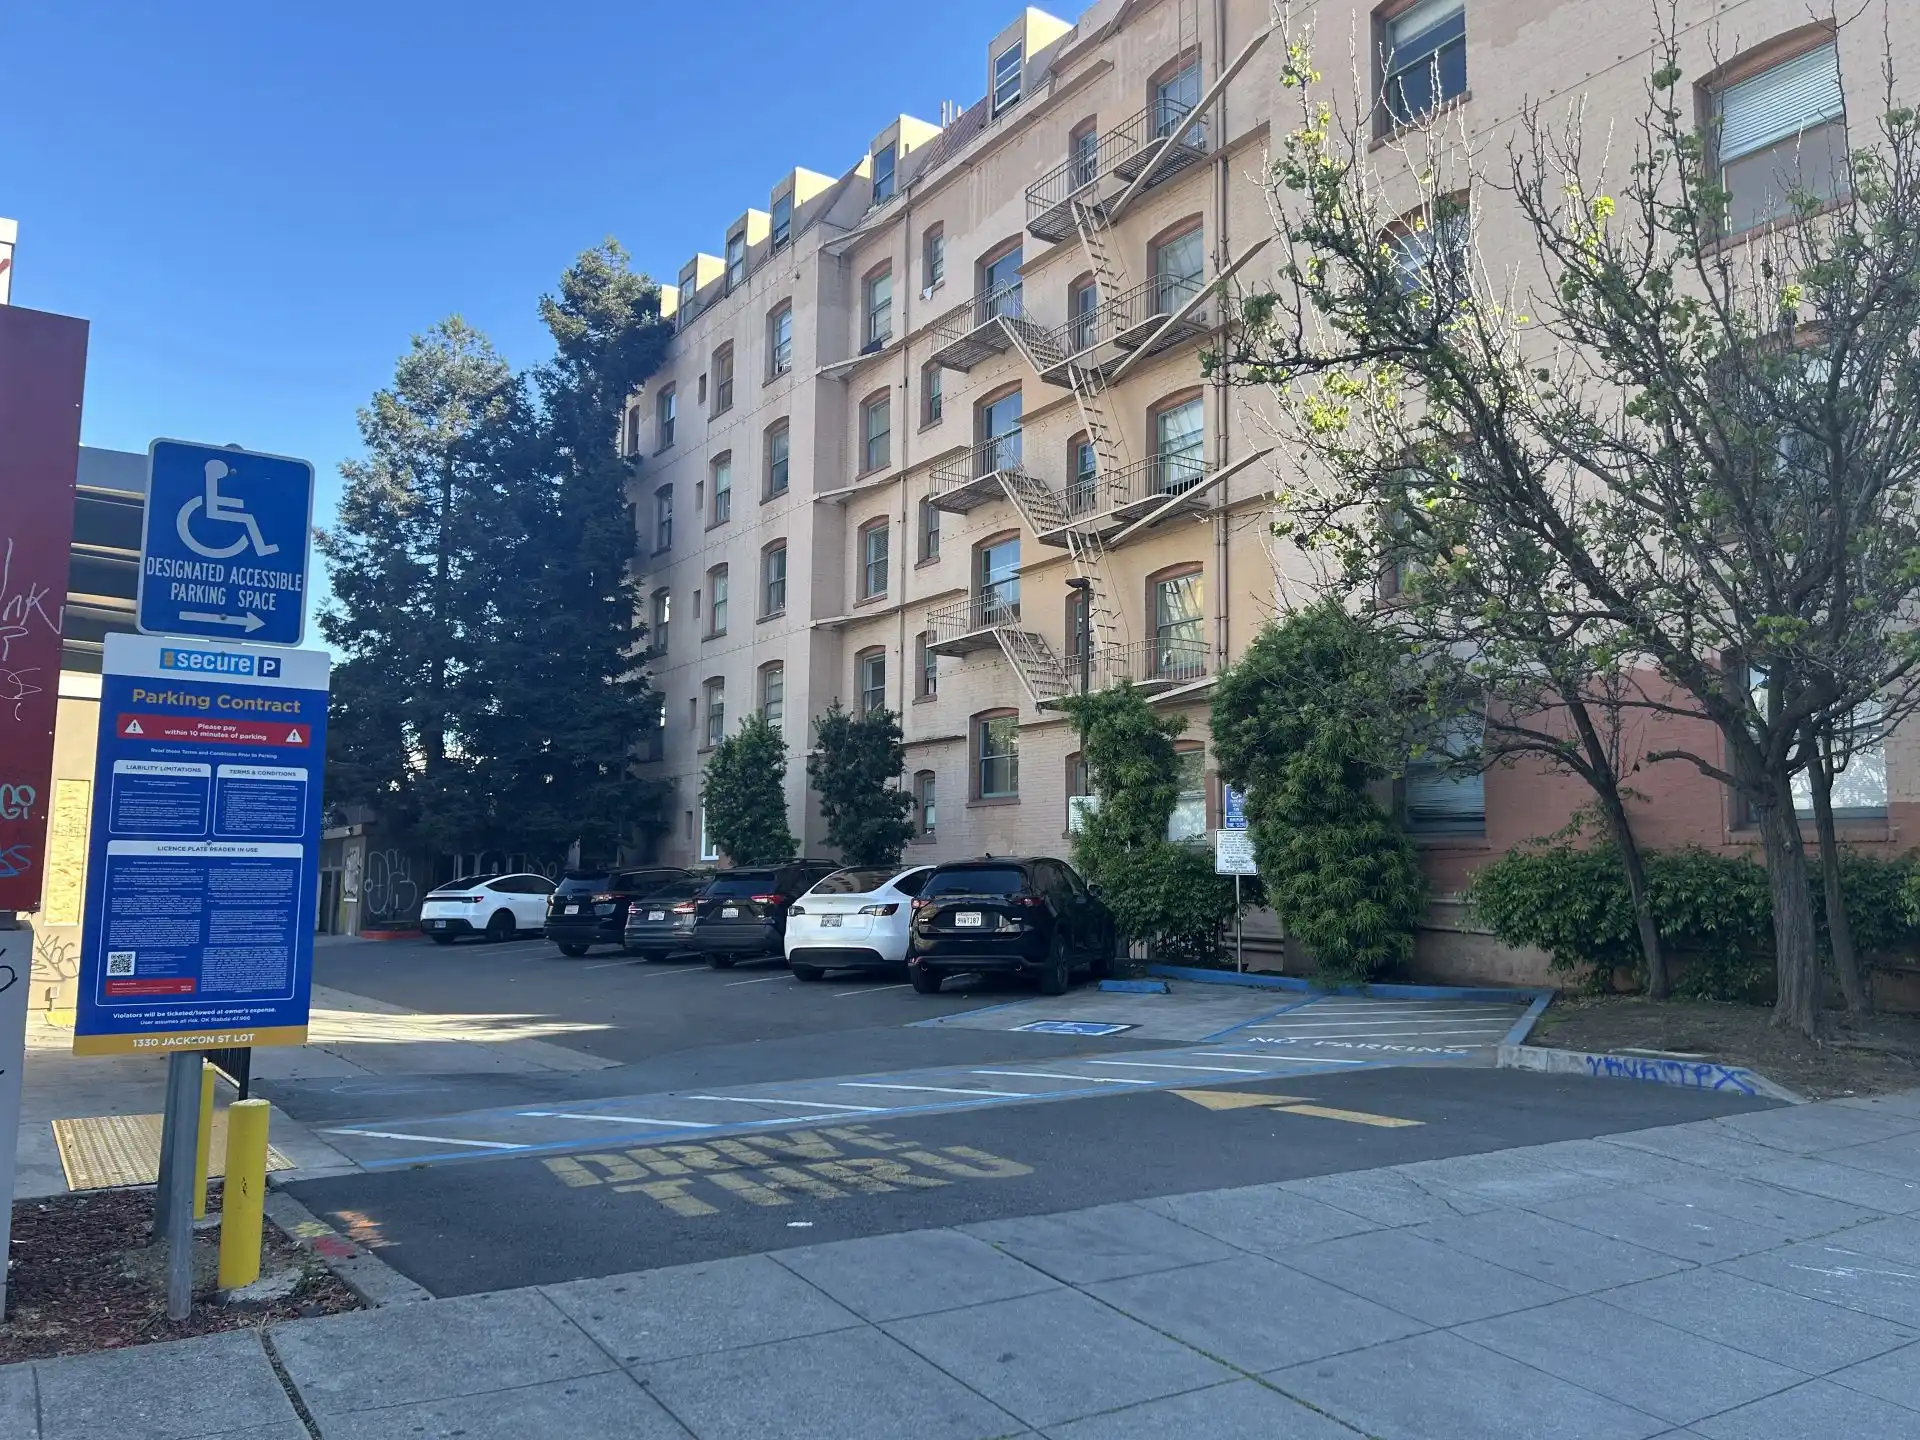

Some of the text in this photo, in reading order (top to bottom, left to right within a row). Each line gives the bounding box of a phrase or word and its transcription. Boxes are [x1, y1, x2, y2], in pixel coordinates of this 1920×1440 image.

[146, 556, 303, 592] DESIGNATED ACCESSIBLE
[170, 582, 277, 611] PARKING SPACE
[176, 652, 276, 674] secure P
[132, 688, 301, 714] Parking Contract
[164, 728, 188, 736] within
[239, 733, 267, 741] parking
[126, 763, 202, 773] LIABILITY LIMITATIONS
[166, 1009, 216, 1017] ticketed/towed
[132, 1038, 159, 1048] 1330
[217, 1034, 232, 1043] ST
[233, 1033, 255, 1042] LOT
[1248, 1036, 1469, 1054] NO PARKING
[541, 1124, 922, 1188] DRIVE
[611, 1145, 1035, 1217] THRU
